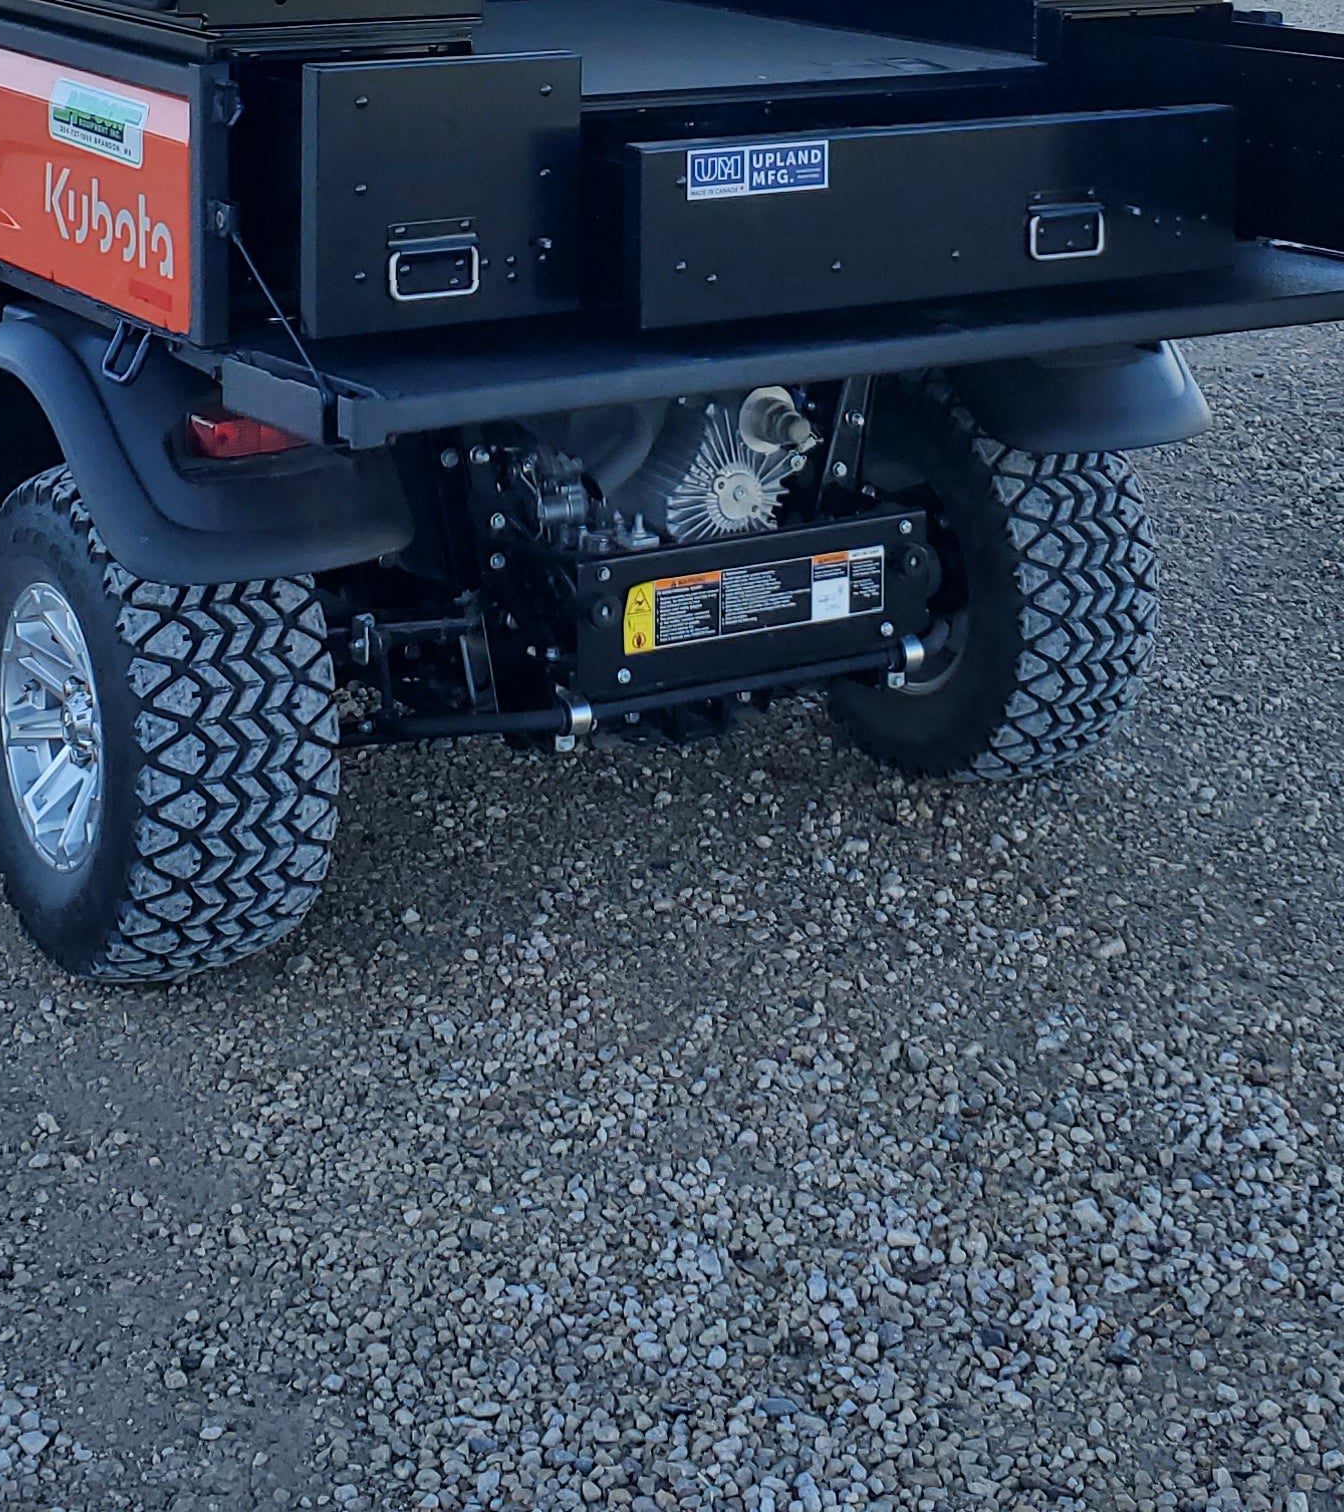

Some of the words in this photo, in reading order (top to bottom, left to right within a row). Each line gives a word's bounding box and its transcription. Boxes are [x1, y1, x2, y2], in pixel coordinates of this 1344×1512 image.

[752, 149, 822, 168] UPLAND
[752, 169, 794, 187] MFG.
[44, 161, 174, 280] Kubota
